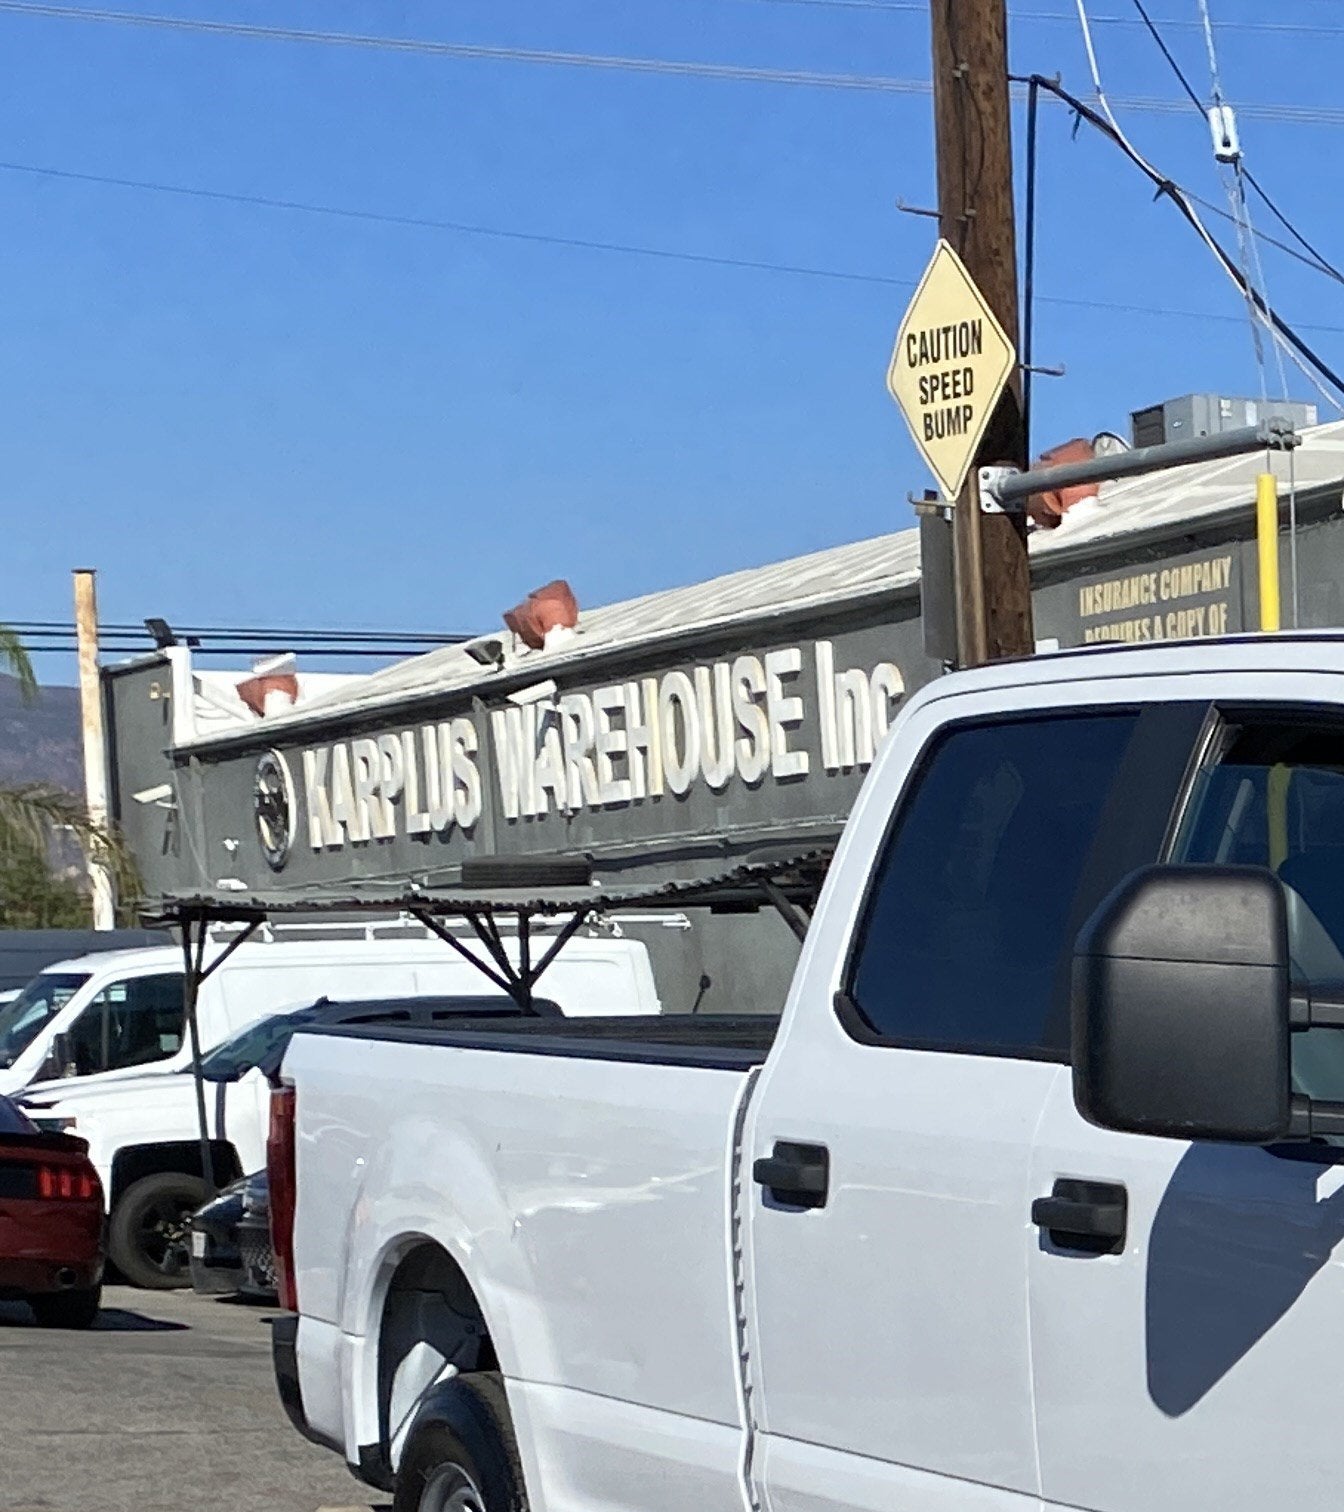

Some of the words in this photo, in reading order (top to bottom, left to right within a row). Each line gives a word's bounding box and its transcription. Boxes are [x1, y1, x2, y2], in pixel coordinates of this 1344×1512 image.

[906, 318, 982, 369] CAUTION
[919, 366, 974, 405] SPEED
[923, 404, 973, 442] BUMP
[1080, 572, 1156, 617] INSURANCE
[1159, 555, 1232, 601] COMPANY
[1154, 615, 1163, 641] A
[1166, 606, 1205, 639] COPY
[1209, 603, 1228, 635] OF
[302, 718, 482, 849] KARPLUS
[490, 647, 810, 819] WAREHOUSE
[815, 640, 905, 770] Inc
